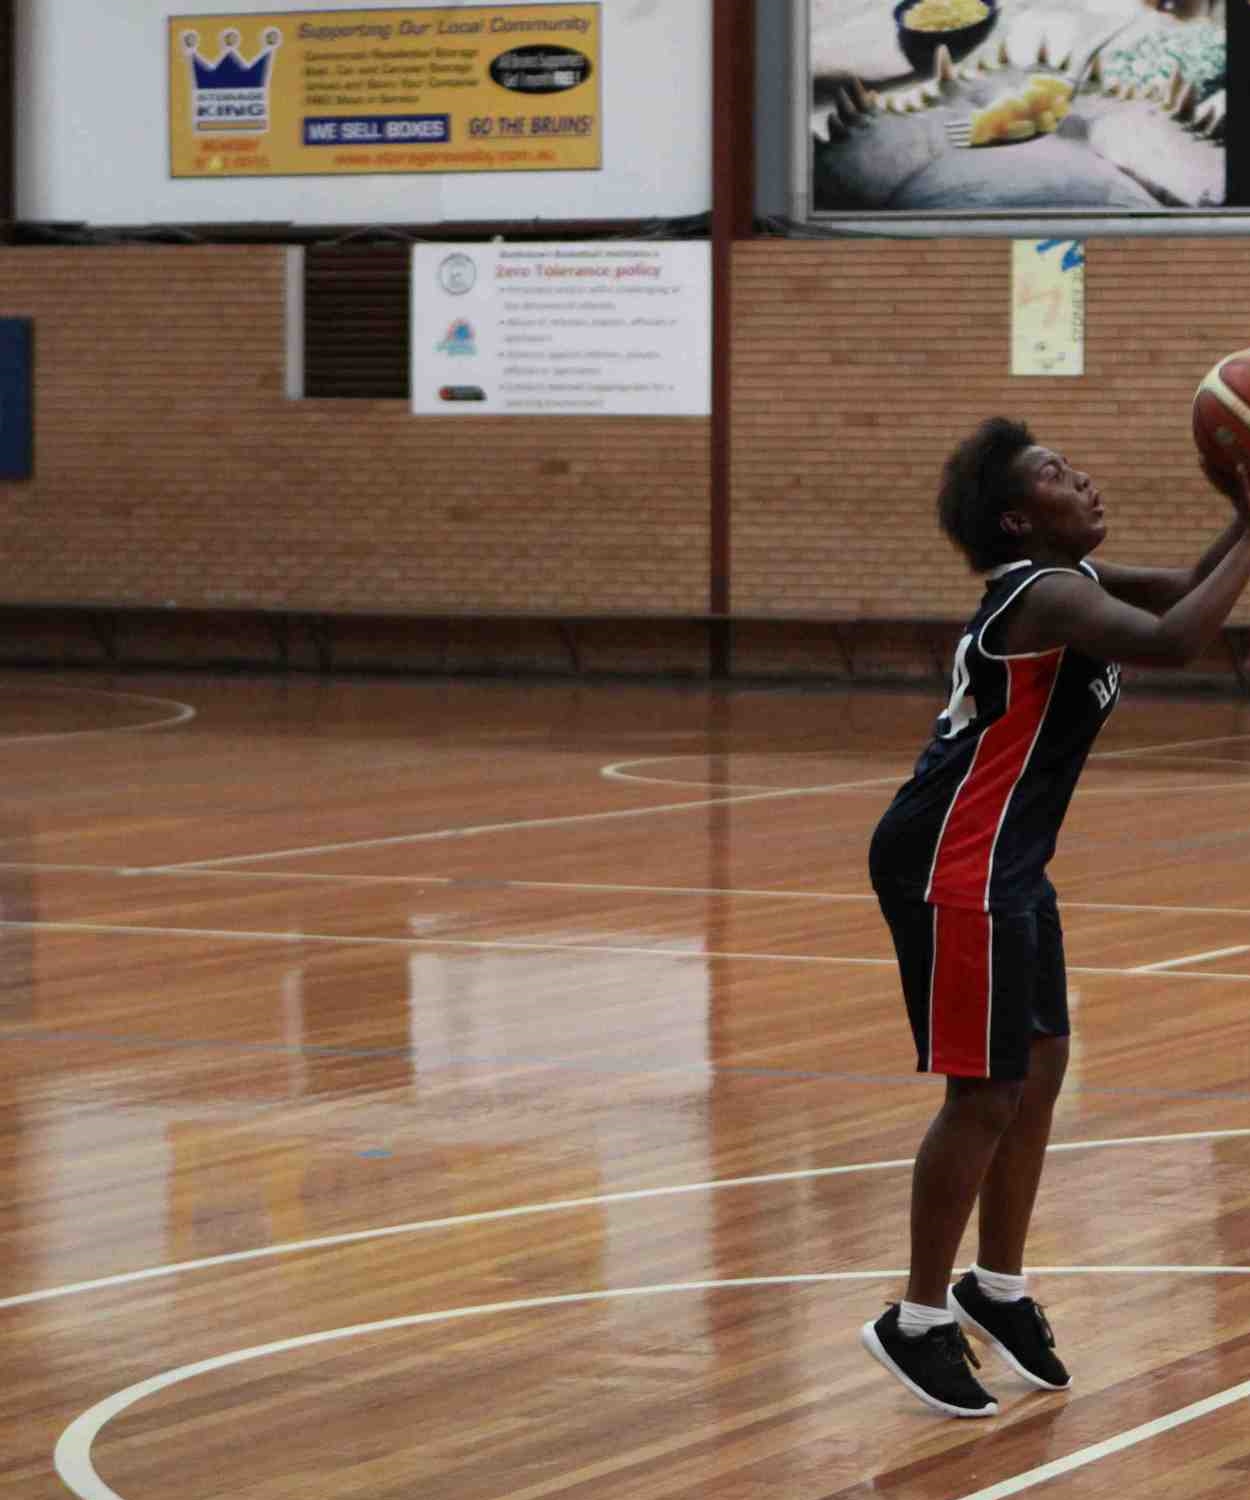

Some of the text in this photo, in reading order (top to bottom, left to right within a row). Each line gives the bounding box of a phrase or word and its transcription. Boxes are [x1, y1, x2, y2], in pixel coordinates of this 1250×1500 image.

[298, 16, 589, 40] Supporting Our Local Community
[197, 103, 264, 116] KING
[307, 120, 446, 140] WE SELL BOXES
[469, 118, 492, 136] GO
[499, 117, 526, 135] THE
[496, 263, 663, 280] Zero Tolerance policy
